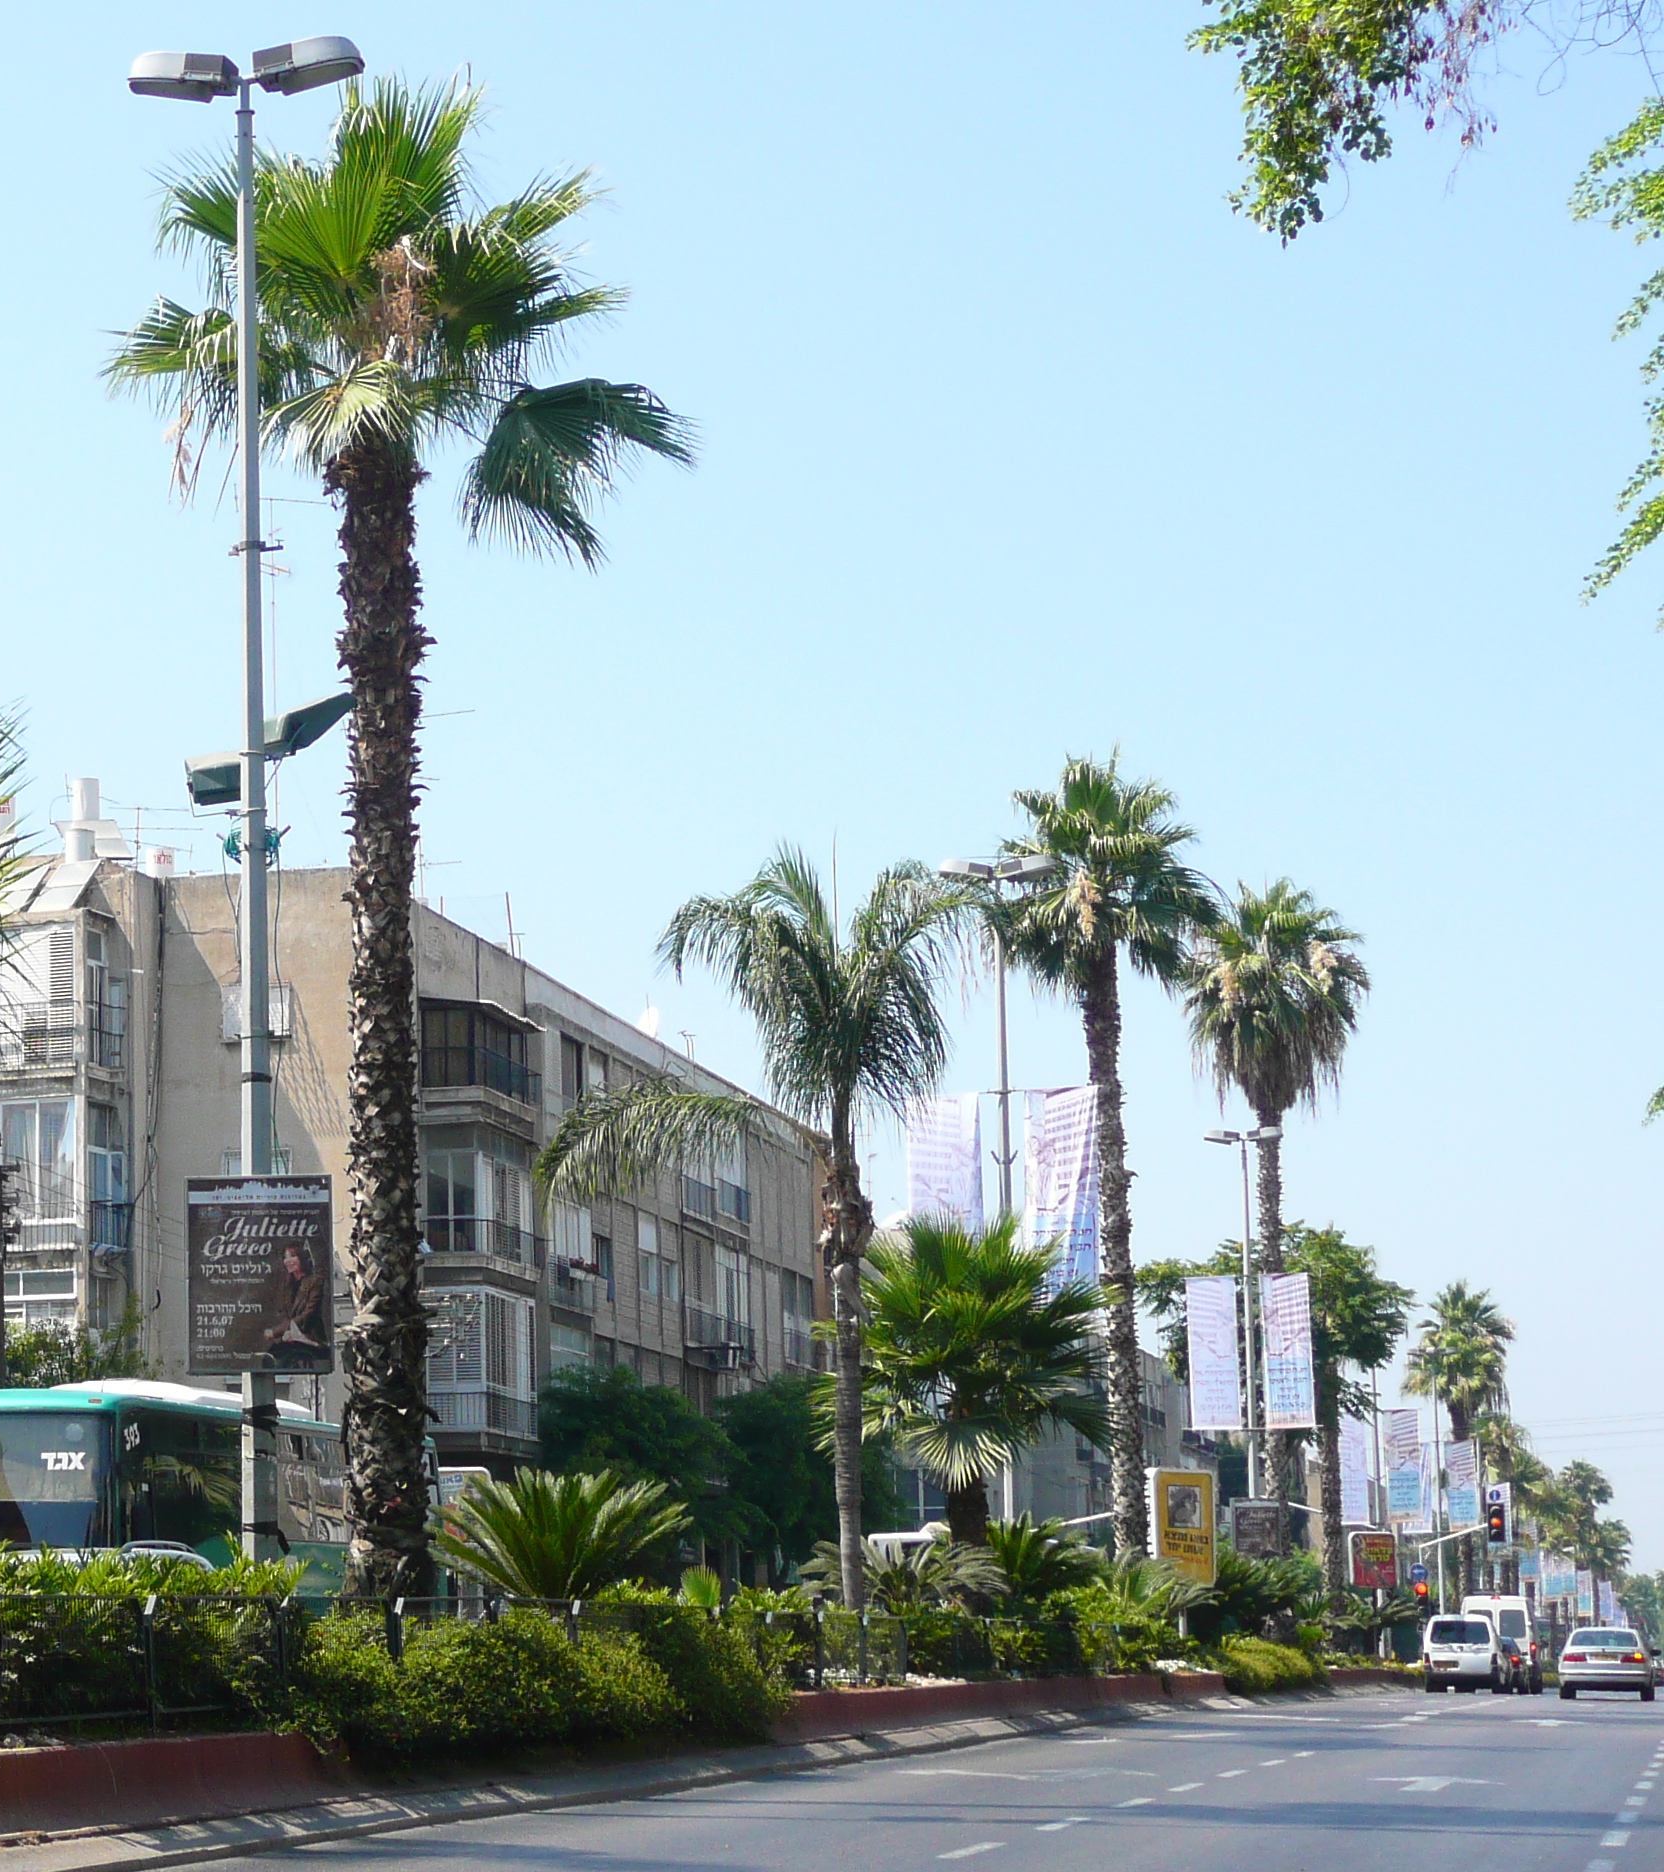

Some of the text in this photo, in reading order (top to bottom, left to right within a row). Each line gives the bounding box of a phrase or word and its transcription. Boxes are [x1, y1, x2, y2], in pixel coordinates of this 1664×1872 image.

[224, 1216, 319, 1241] Juliette
[201, 1263, 228, 1277] גרקו
[196, 1301, 262, 1314] היכל התרבות
[196, 1328, 226, 1338] 21:00
[124, 1422, 140, 1451] 393
[40, 1452, 86, 1470] אגד
